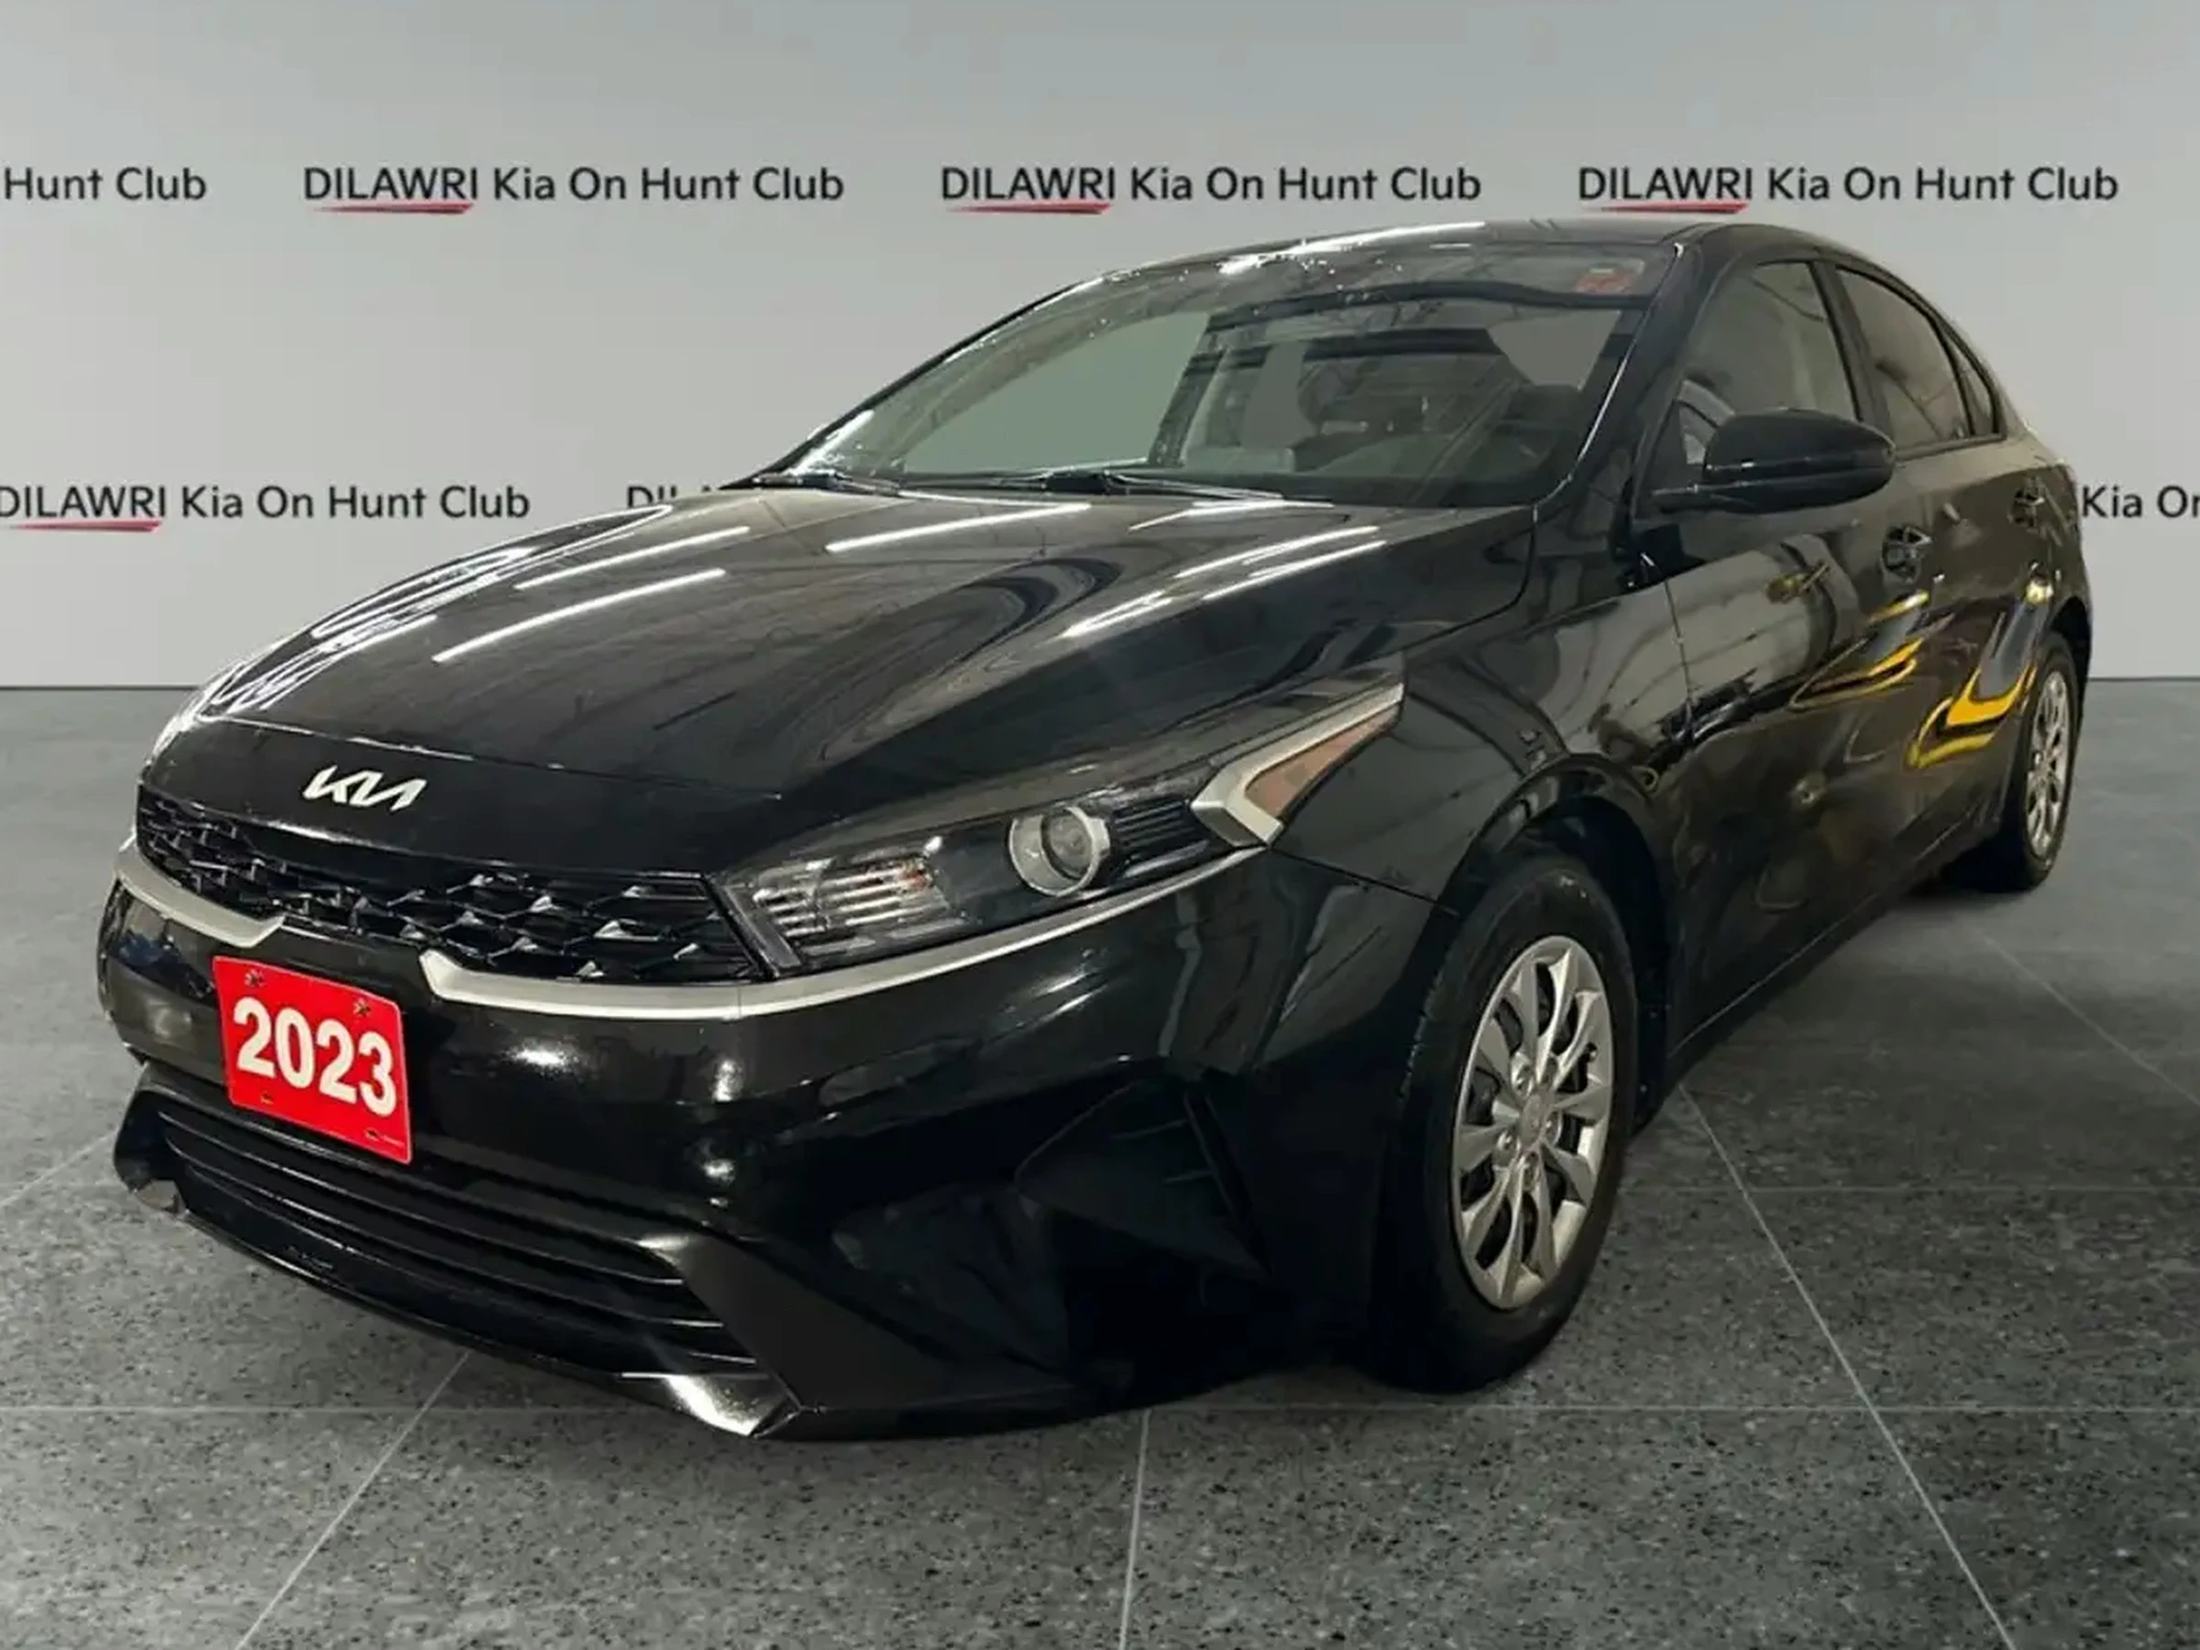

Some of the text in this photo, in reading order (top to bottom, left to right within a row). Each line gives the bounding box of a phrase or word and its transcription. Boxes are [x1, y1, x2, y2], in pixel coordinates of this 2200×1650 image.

[4, 167, 207, 200] Hunt Club
[304, 167, 843, 200] DILAWRI Kia On Hunt Club
[942, 167, 1481, 200] DILAWRI Kia On Hunt Club
[1579, 167, 2118, 200] DILAWRI Kia On Hunt Club
[0, 485, 530, 518] DILAWRI Kia On Hunt Club
[2081, 485, 2143, 518] Kia
[232, 997, 397, 1117] 2023
